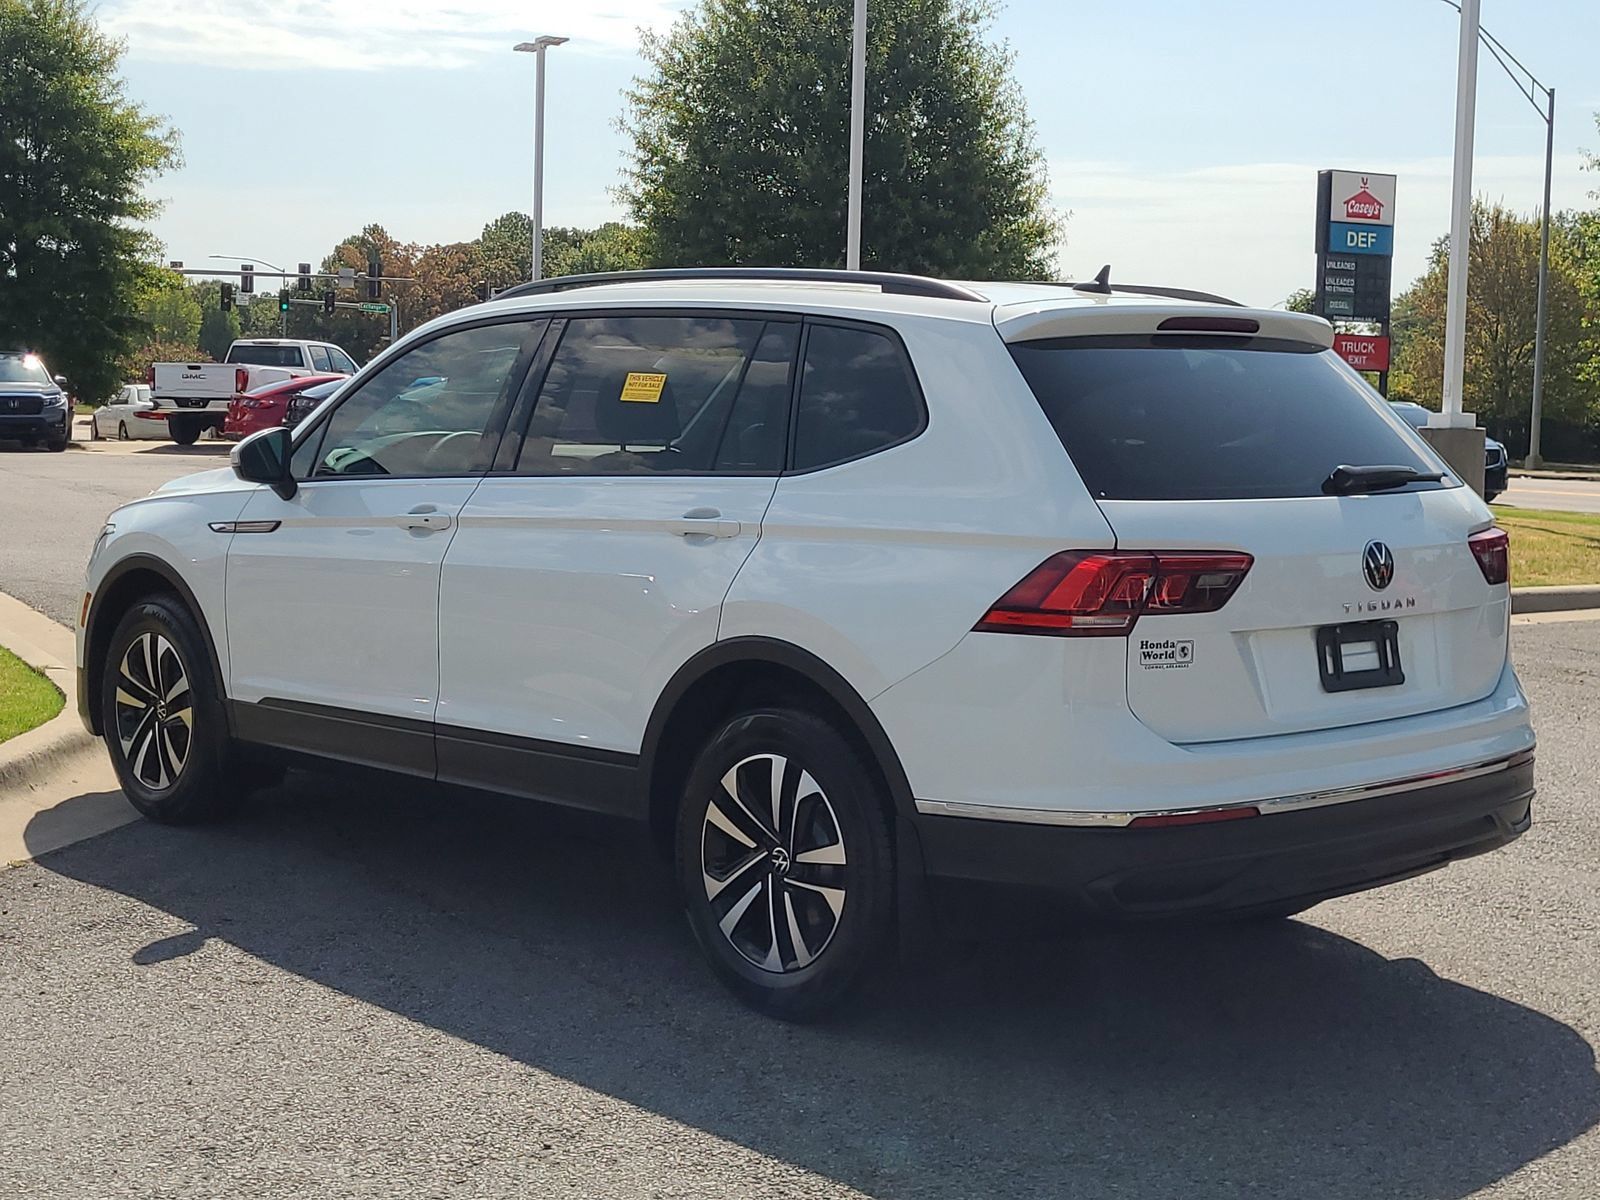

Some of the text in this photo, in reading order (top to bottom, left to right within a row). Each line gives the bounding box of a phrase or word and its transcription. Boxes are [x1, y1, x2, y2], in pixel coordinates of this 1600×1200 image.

[1348, 200, 1380, 217] Casey's
[1347, 231, 1377, 248] DEF
[1326, 260, 1356, 270] UNLEADED
[1325, 277, 1355, 286] UNLEADED
[1329, 301, 1349, 309] DIESEL
[1341, 341, 1376, 354] TRUCK
[1348, 355, 1367, 365] EXIT
[1342, 597, 1416, 614] TIGUAN
[1140, 639, 1175, 650] Honda
[1142, 650, 1175, 660] World
